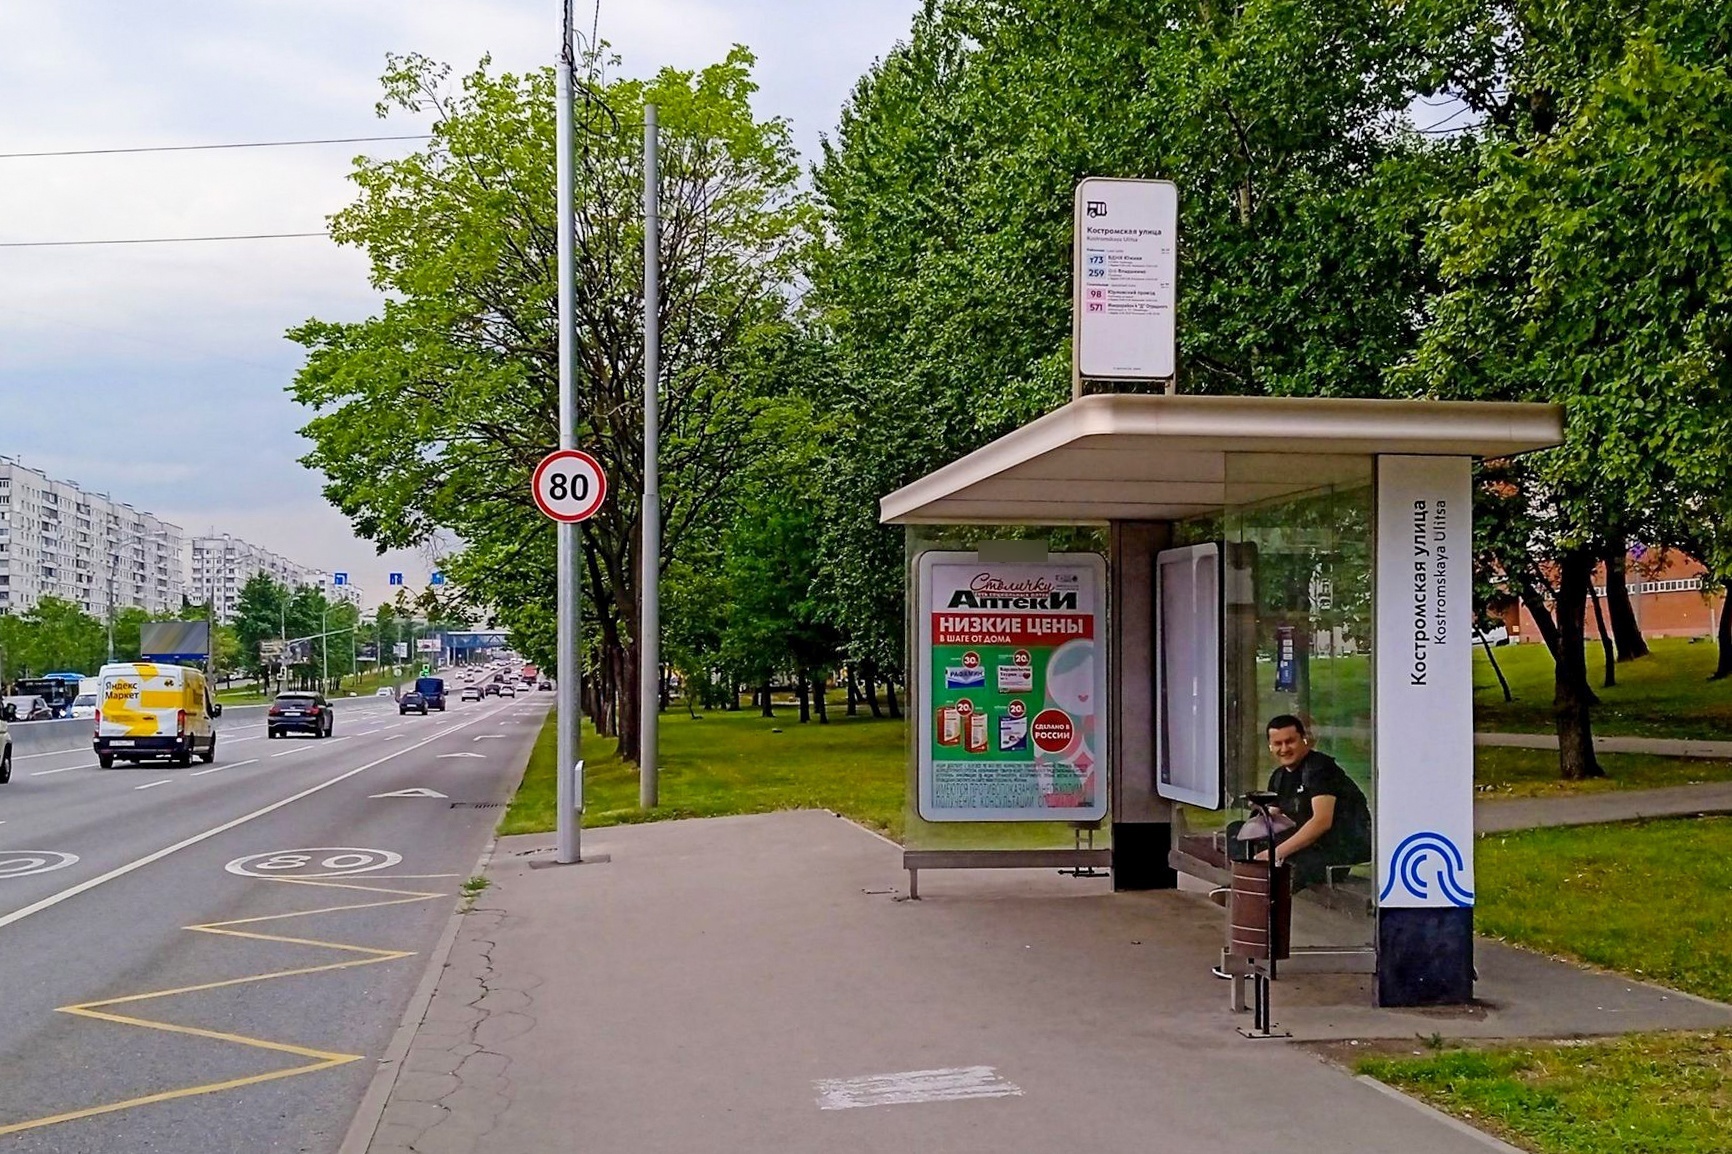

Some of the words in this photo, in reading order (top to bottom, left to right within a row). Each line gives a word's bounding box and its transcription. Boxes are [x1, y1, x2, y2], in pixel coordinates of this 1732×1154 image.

[1086, 226, 1138, 236] Костромская
[1139, 229, 1162, 237] улица
[1088, 268, 1105, 277] 259
[1090, 290, 1102, 298] 98
[549, 472, 589, 501] 80
[1414, 500, 1430, 556] улица
[1433, 500, 1446, 541] Ulitsa
[970, 572, 1055, 592] Столички
[1433, 545, 1448, 645] Kostromskaya
[939, 617, 1022, 633] НИЗКИЕ
[1026, 618, 1083, 635] ЦЕНЫ
[1410, 561, 1430, 686] Костромская
[939, 635, 945, 643] В
[946, 635, 970, 643] ШАГЕ
[971, 635, 982, 643] ОТ
[983, 635, 1012, 643] ДОМА
[105, 681, 138, 691] Яндекс
[105, 691, 140, 700] Маркет
[256, 854, 374, 870] 80
